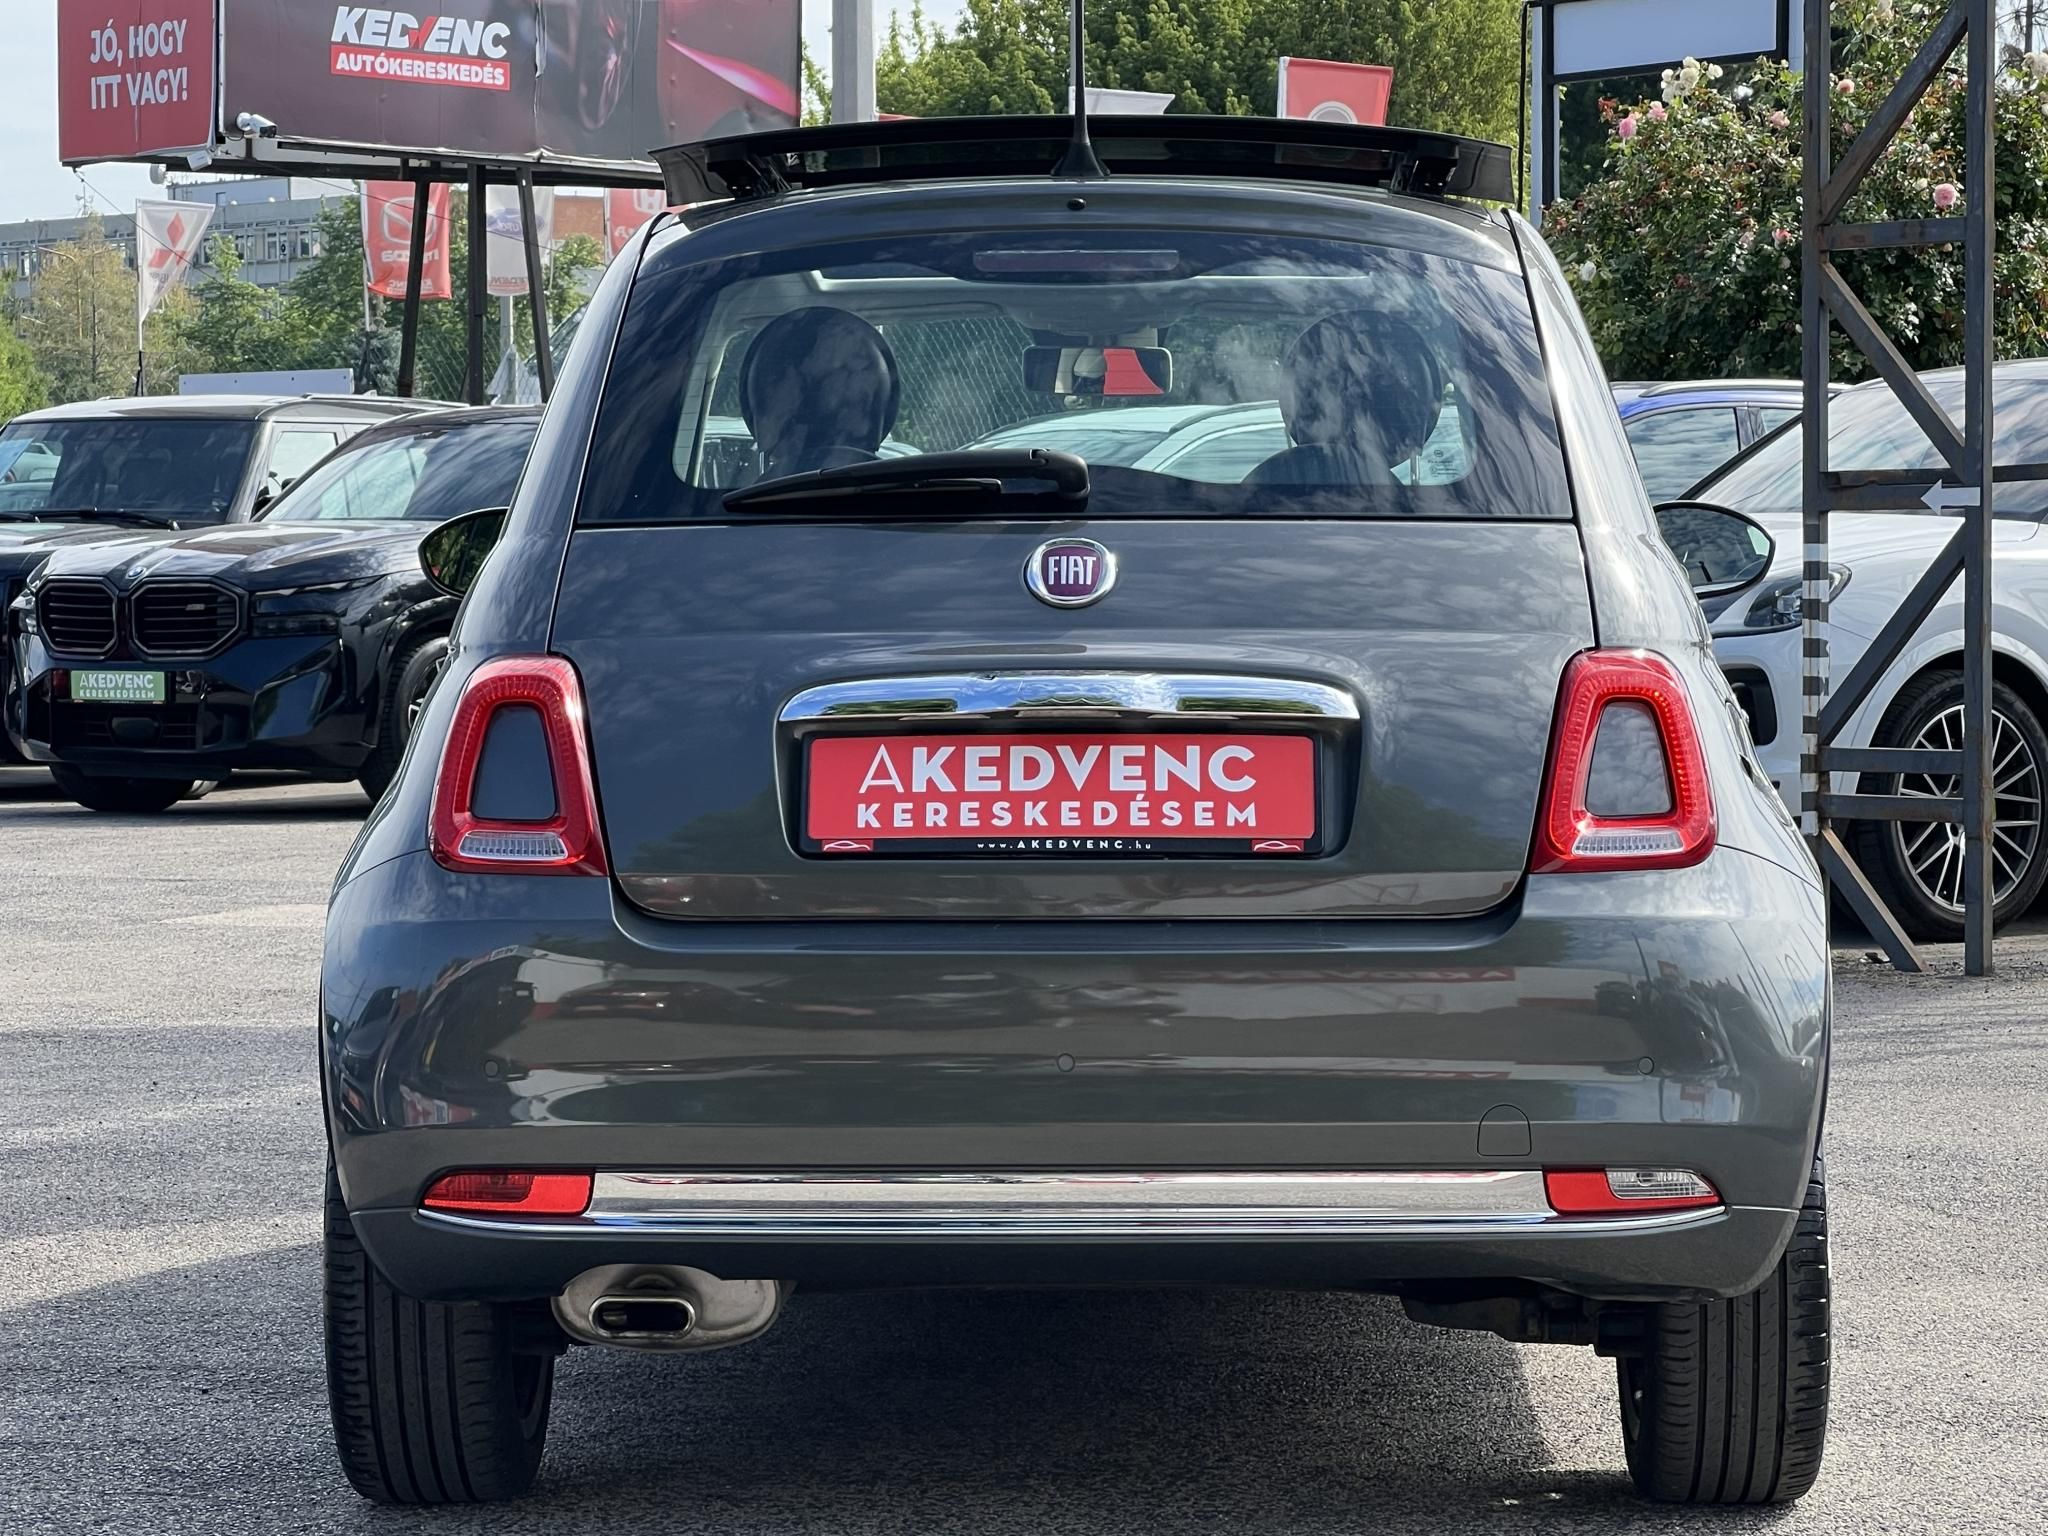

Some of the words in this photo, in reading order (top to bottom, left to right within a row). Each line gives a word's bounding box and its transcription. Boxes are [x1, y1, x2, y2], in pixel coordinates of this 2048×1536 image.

[90, 18, 123, 67] JÓ,
[128, 19, 187, 59] HOGY
[331, 6, 511, 59] KEDVENC
[336, 53, 505, 85] AUTÓKERESKEDÉS
[91, 74, 121, 110] ITT
[126, 67, 188, 106] VAGY!
[1048, 555, 1097, 585] FIAT
[80, 673, 154, 689] AKEDVENC
[858, 743, 1257, 794] AKEDVENC
[857, 794, 1257, 828] KERESKEDÉSEM
[977, 840, 1151, 849] www.AKEDVENC.hu
